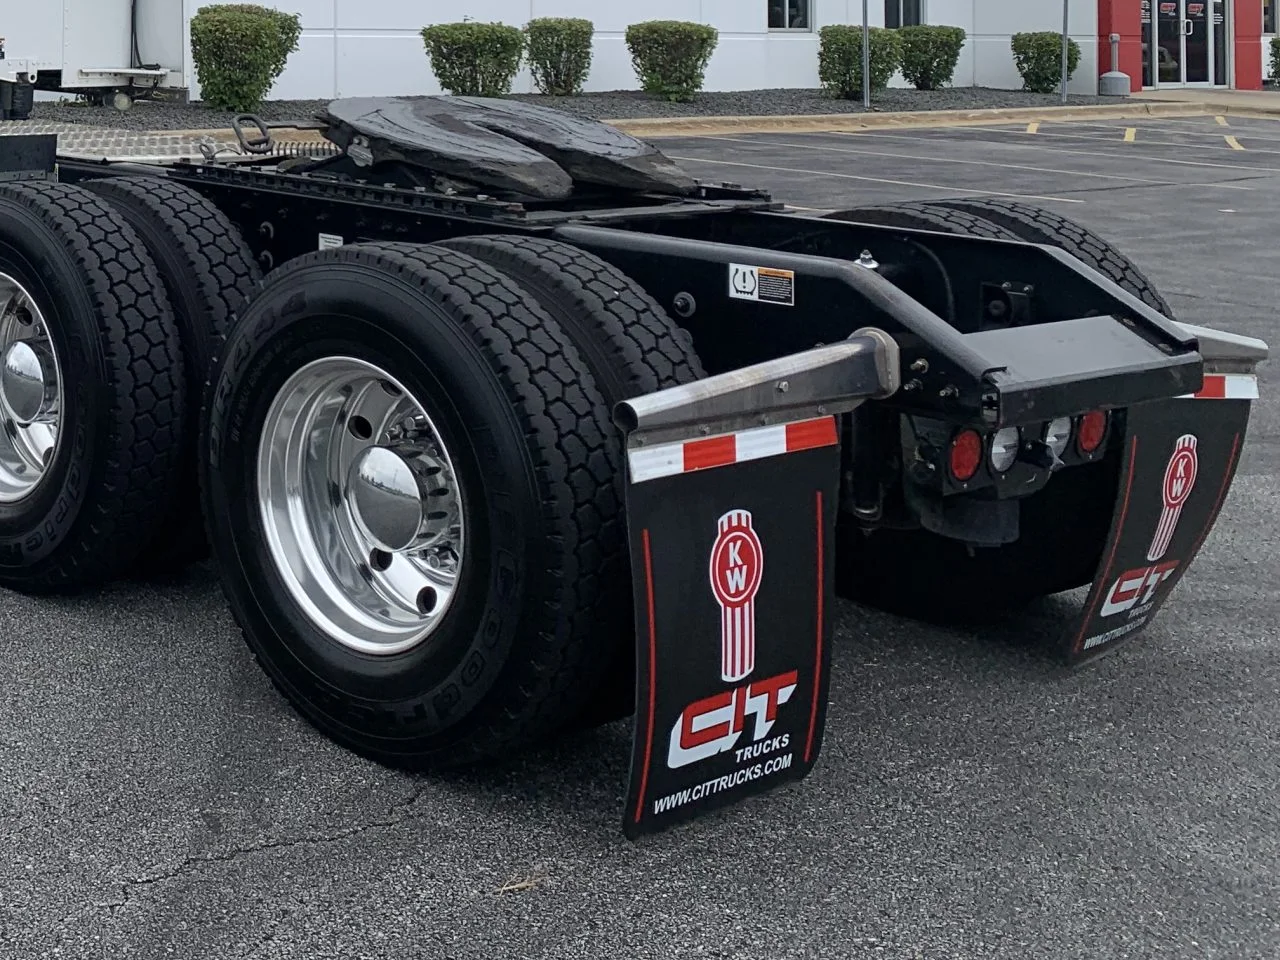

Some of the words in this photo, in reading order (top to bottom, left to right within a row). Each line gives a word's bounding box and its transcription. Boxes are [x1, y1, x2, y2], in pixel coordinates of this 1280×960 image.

[726, 540, 747, 594] KW
[1105, 560, 1179, 612] CIT
[672, 670, 797, 760] CIT
[735, 733, 790, 763] TRUCKS
[654, 753, 793, 814] WWW.CITTRUCKS.COM
